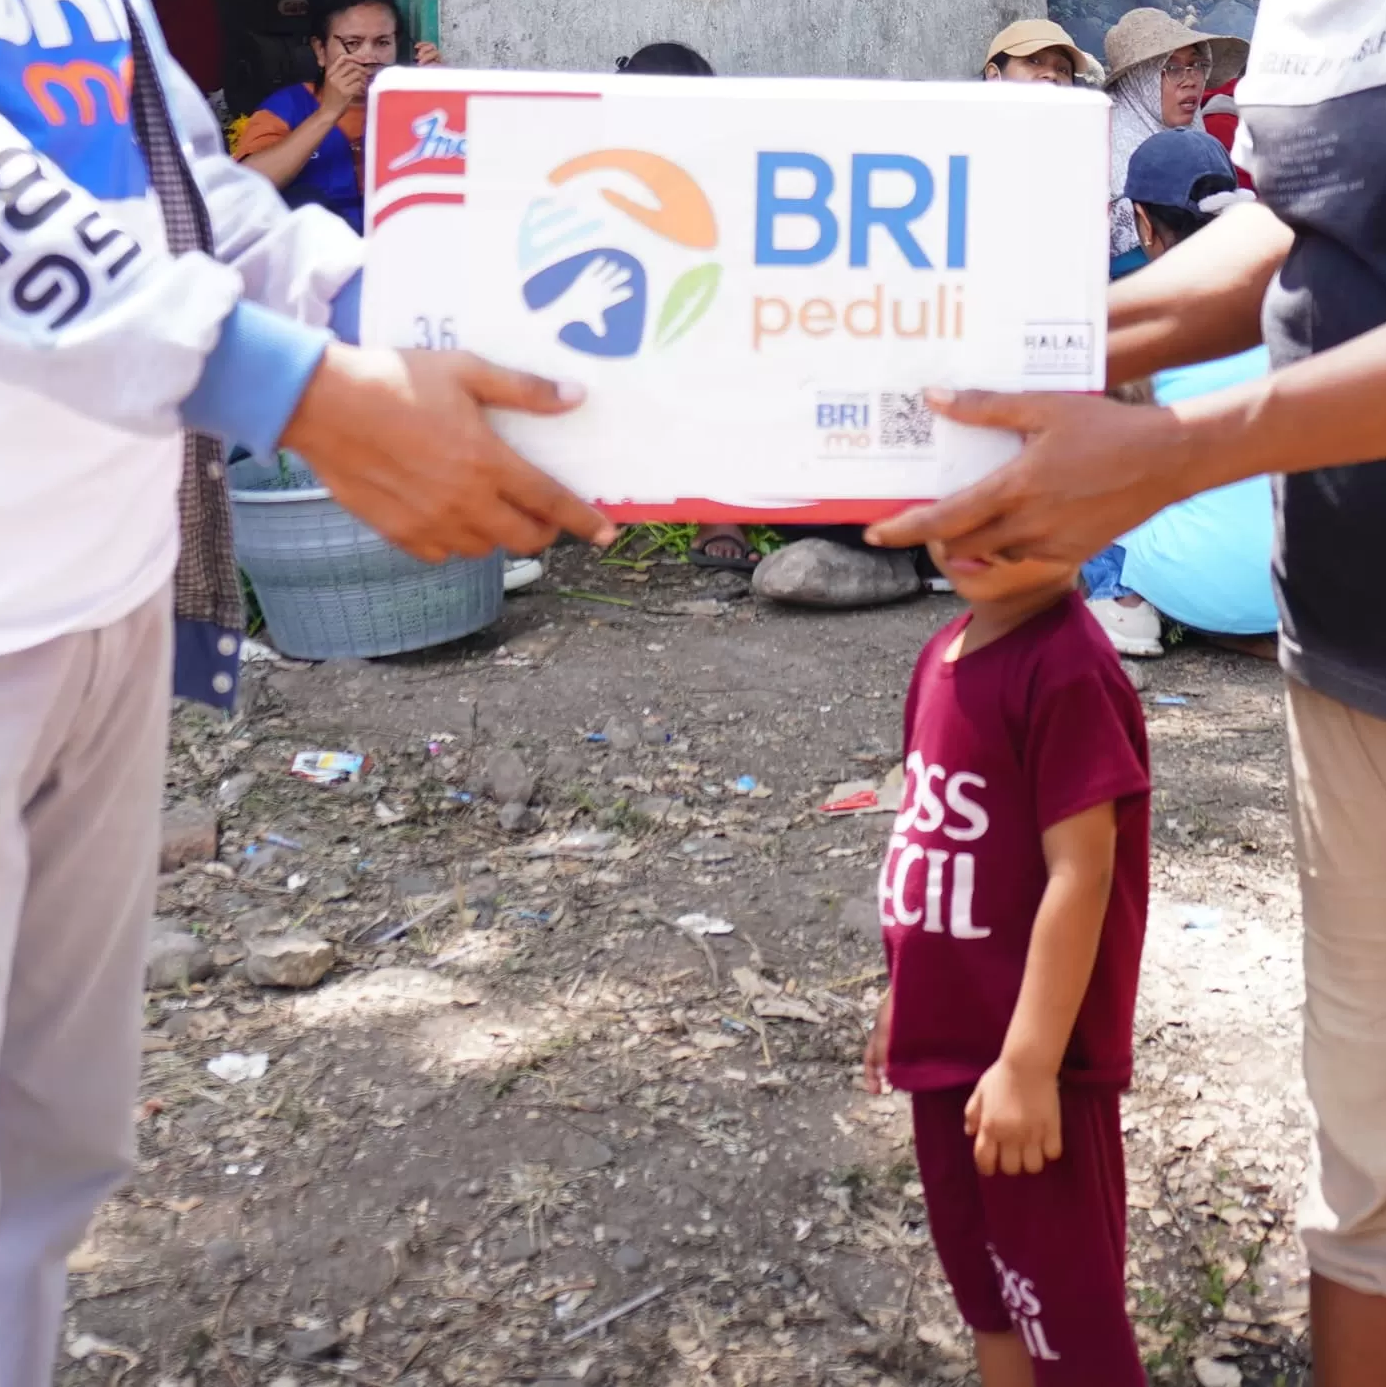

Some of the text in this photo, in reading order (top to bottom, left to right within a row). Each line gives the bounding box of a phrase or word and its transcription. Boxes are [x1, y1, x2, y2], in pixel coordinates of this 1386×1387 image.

[22, 57, 134, 126] m
[754, 151, 969, 270] BRI
[753, 283, 965, 352] peduli
[1024, 334, 1091, 350] HALAL
[816, 403, 869, 428] BRI
[824, 433, 871, 449] mo
